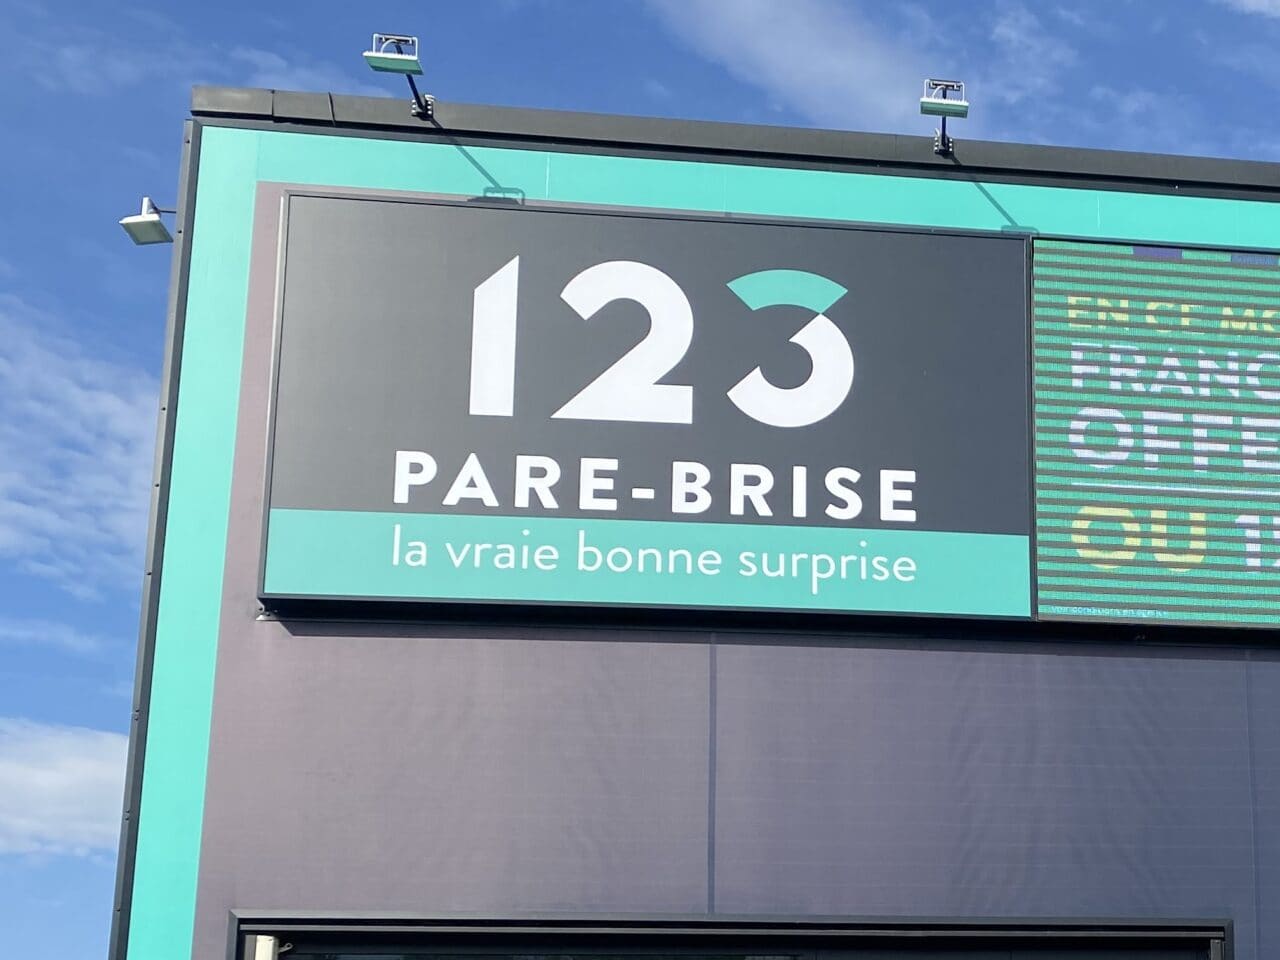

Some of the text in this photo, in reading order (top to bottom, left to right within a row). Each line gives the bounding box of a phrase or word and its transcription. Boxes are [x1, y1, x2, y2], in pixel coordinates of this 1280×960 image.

[469, 255, 855, 428] 123
[1067, 296, 1129, 331] EN
[392, 450, 917, 522] PARE-BRISE
[392, 524, 918, 594] la vraie bonne surprise
[1071, 505, 1206, 573] OU
